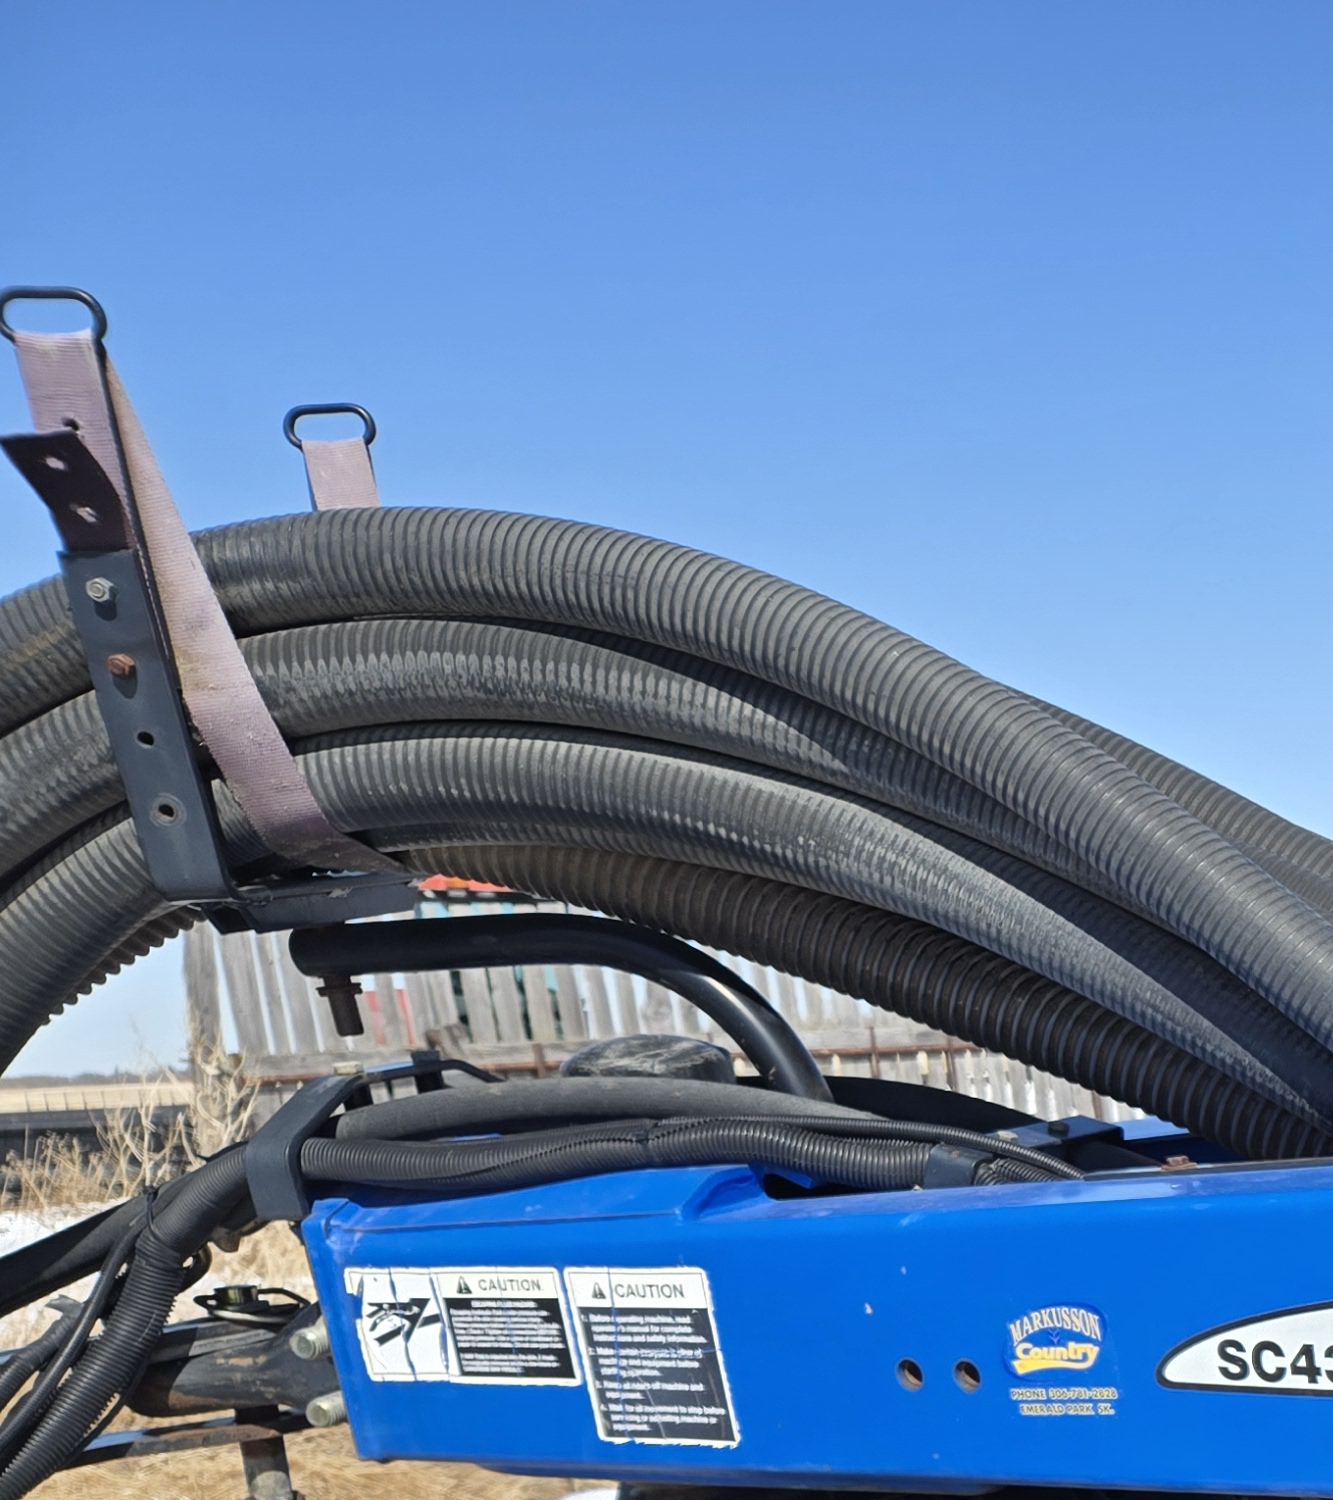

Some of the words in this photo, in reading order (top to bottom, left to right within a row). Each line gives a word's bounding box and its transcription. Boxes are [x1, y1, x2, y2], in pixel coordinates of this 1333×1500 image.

[478, 1279, 541, 1291] CAUTION
[614, 1284, 685, 1298] CAUTION
[1009, 1306, 1102, 1346] MARKUSSON
[1014, 1341, 1099, 1369] Country
[1010, 1388, 1046, 1399] PHONE
[1020, 1403, 1064, 1415] EMERALD
